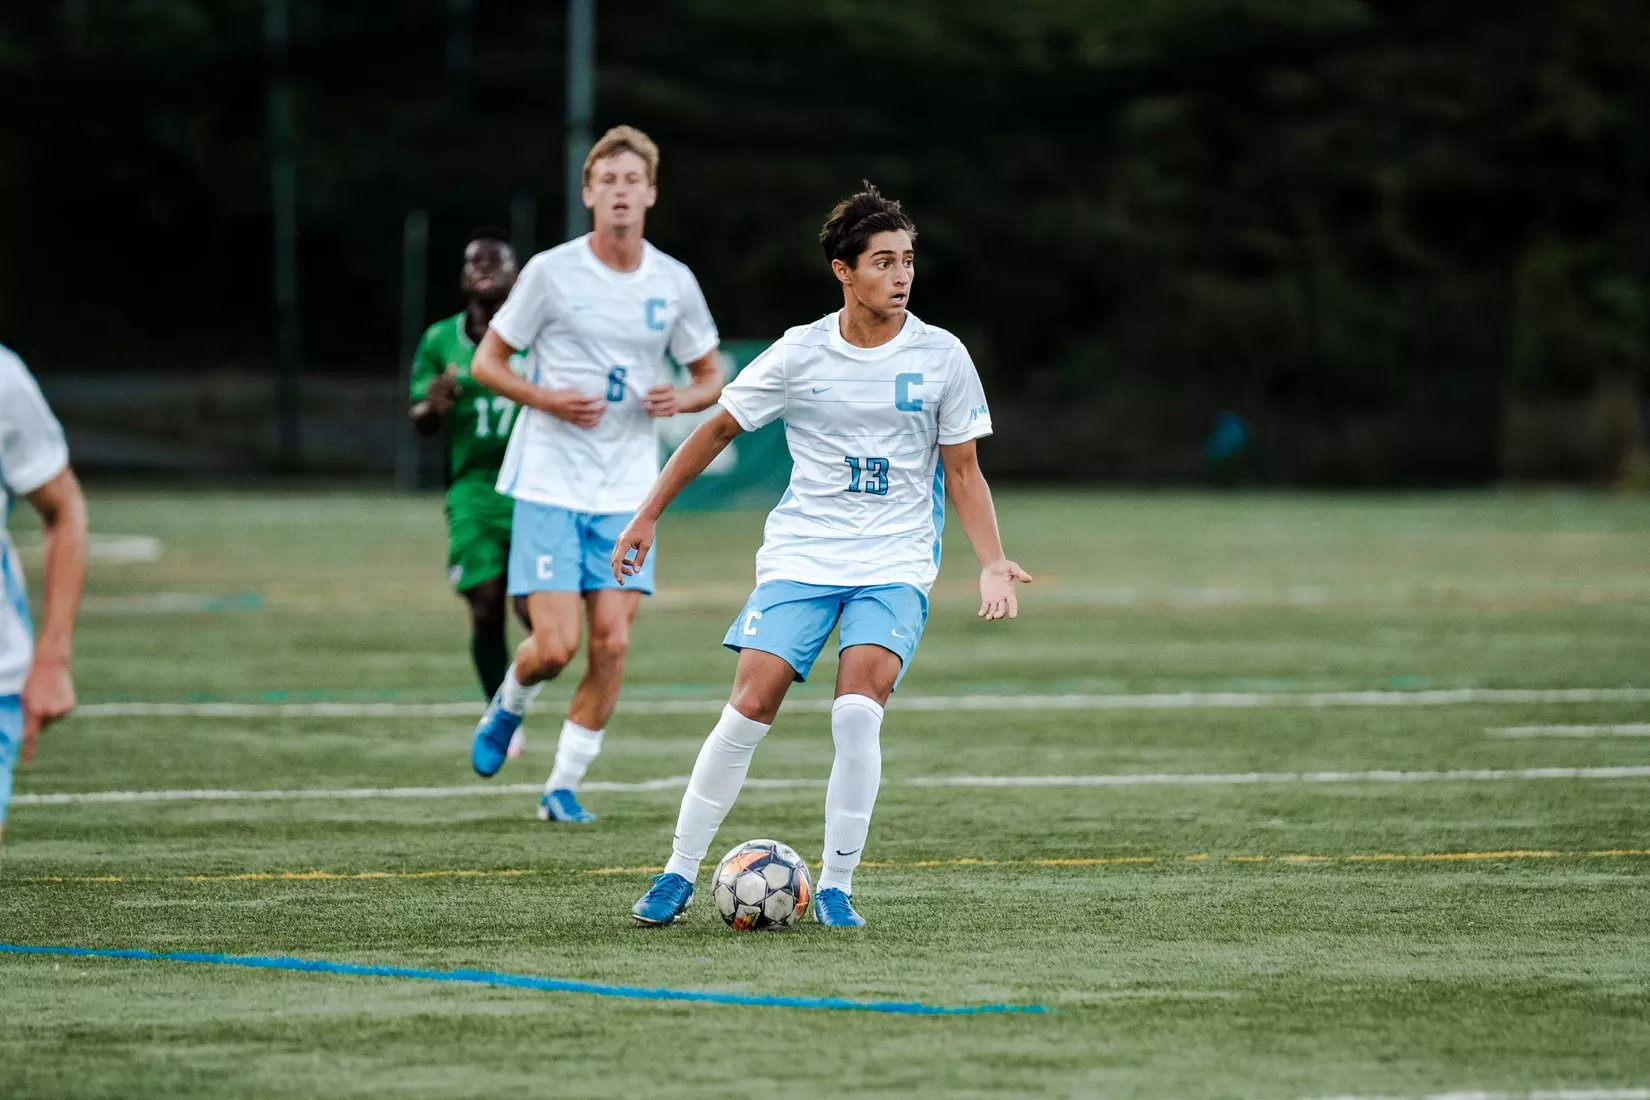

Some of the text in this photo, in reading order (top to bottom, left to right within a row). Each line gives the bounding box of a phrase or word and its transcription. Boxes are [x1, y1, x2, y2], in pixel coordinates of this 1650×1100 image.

[644, 298, 667, 330] C
[607, 366, 627, 402] 6
[895, 373, 922, 412] C
[474, 396, 516, 437] 17
[843, 456, 889, 495] 13
[536, 555, 553, 579] C
[743, 611, 762, 636] C
